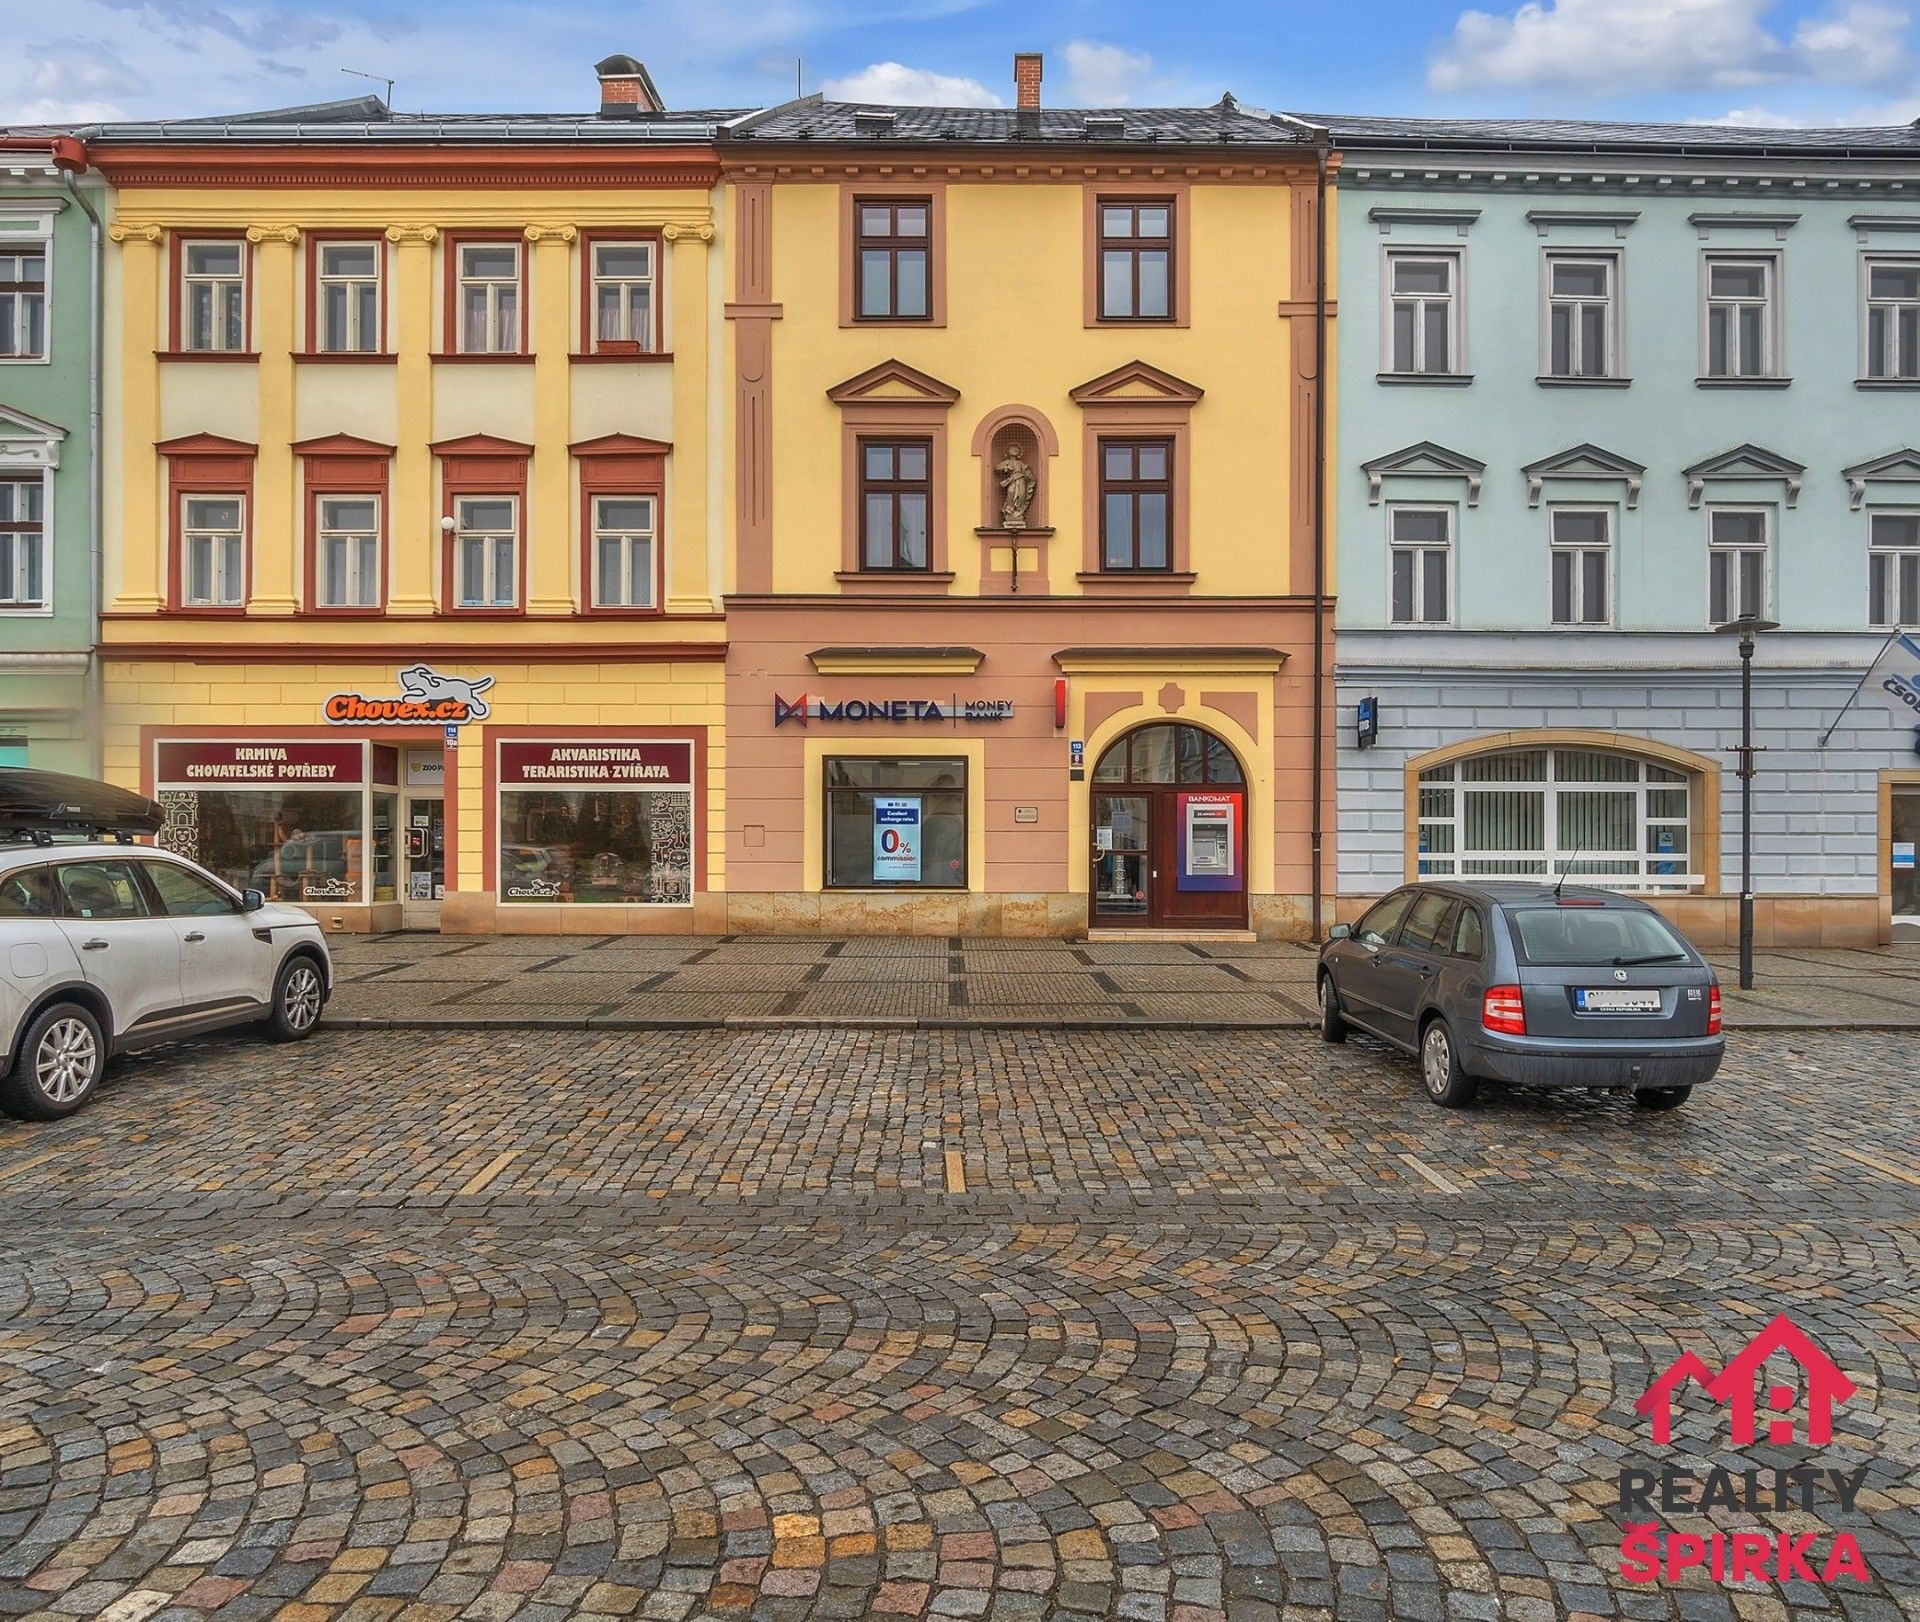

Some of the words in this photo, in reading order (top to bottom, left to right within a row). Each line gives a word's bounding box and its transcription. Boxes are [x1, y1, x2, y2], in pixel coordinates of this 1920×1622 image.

[326, 695, 468, 720] Chovex.cz
[819, 700, 945, 721] MONETA
[965, 701, 1013, 710] MONEY
[235, 748, 288, 761] KRMIVA
[550, 748, 641, 761] AKVARISTIKA
[186, 763, 274, 778] CHOVATELSKÉ
[278, 762, 337, 778] POTŘEBY
